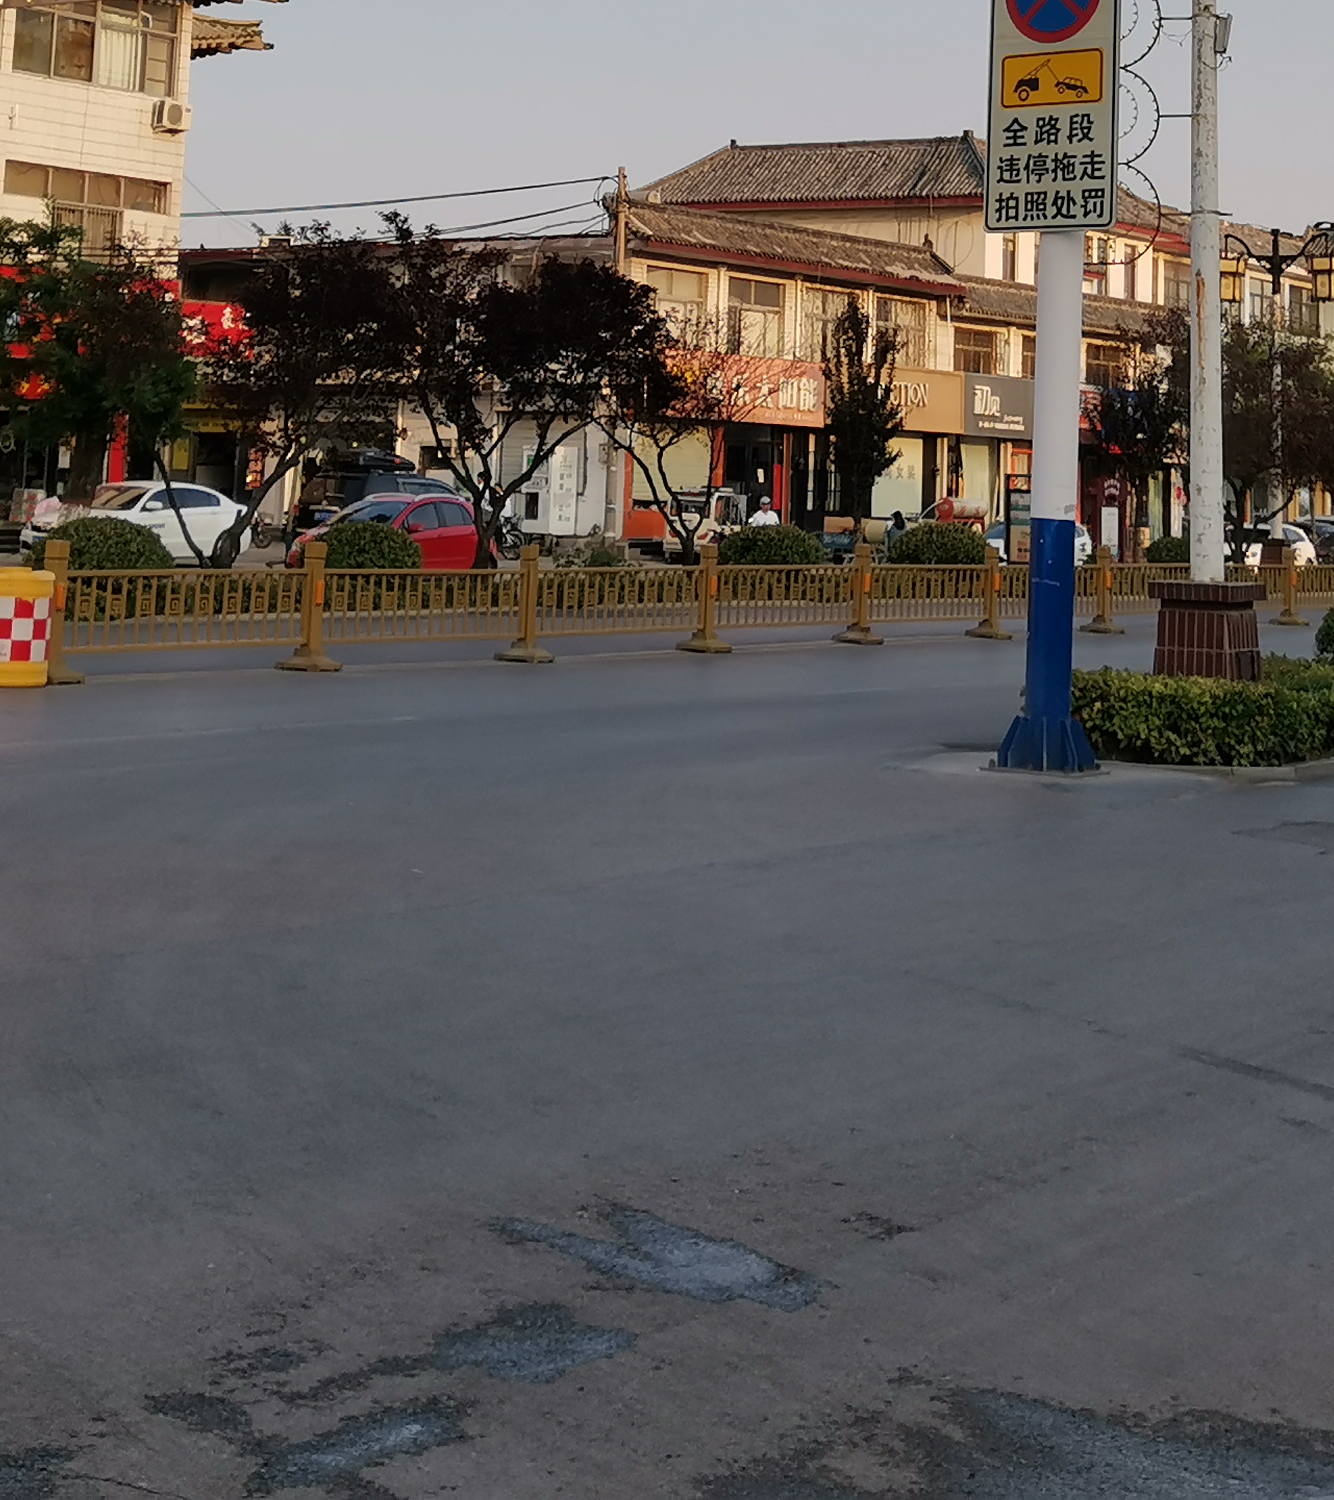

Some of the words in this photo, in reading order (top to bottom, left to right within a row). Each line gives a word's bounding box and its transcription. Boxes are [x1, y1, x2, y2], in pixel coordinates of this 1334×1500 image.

[1002, 113, 1095, 148] 全路段
[996, 150, 1106, 184] 违停拖走
[995, 188, 1106, 223] 拍照处罚
